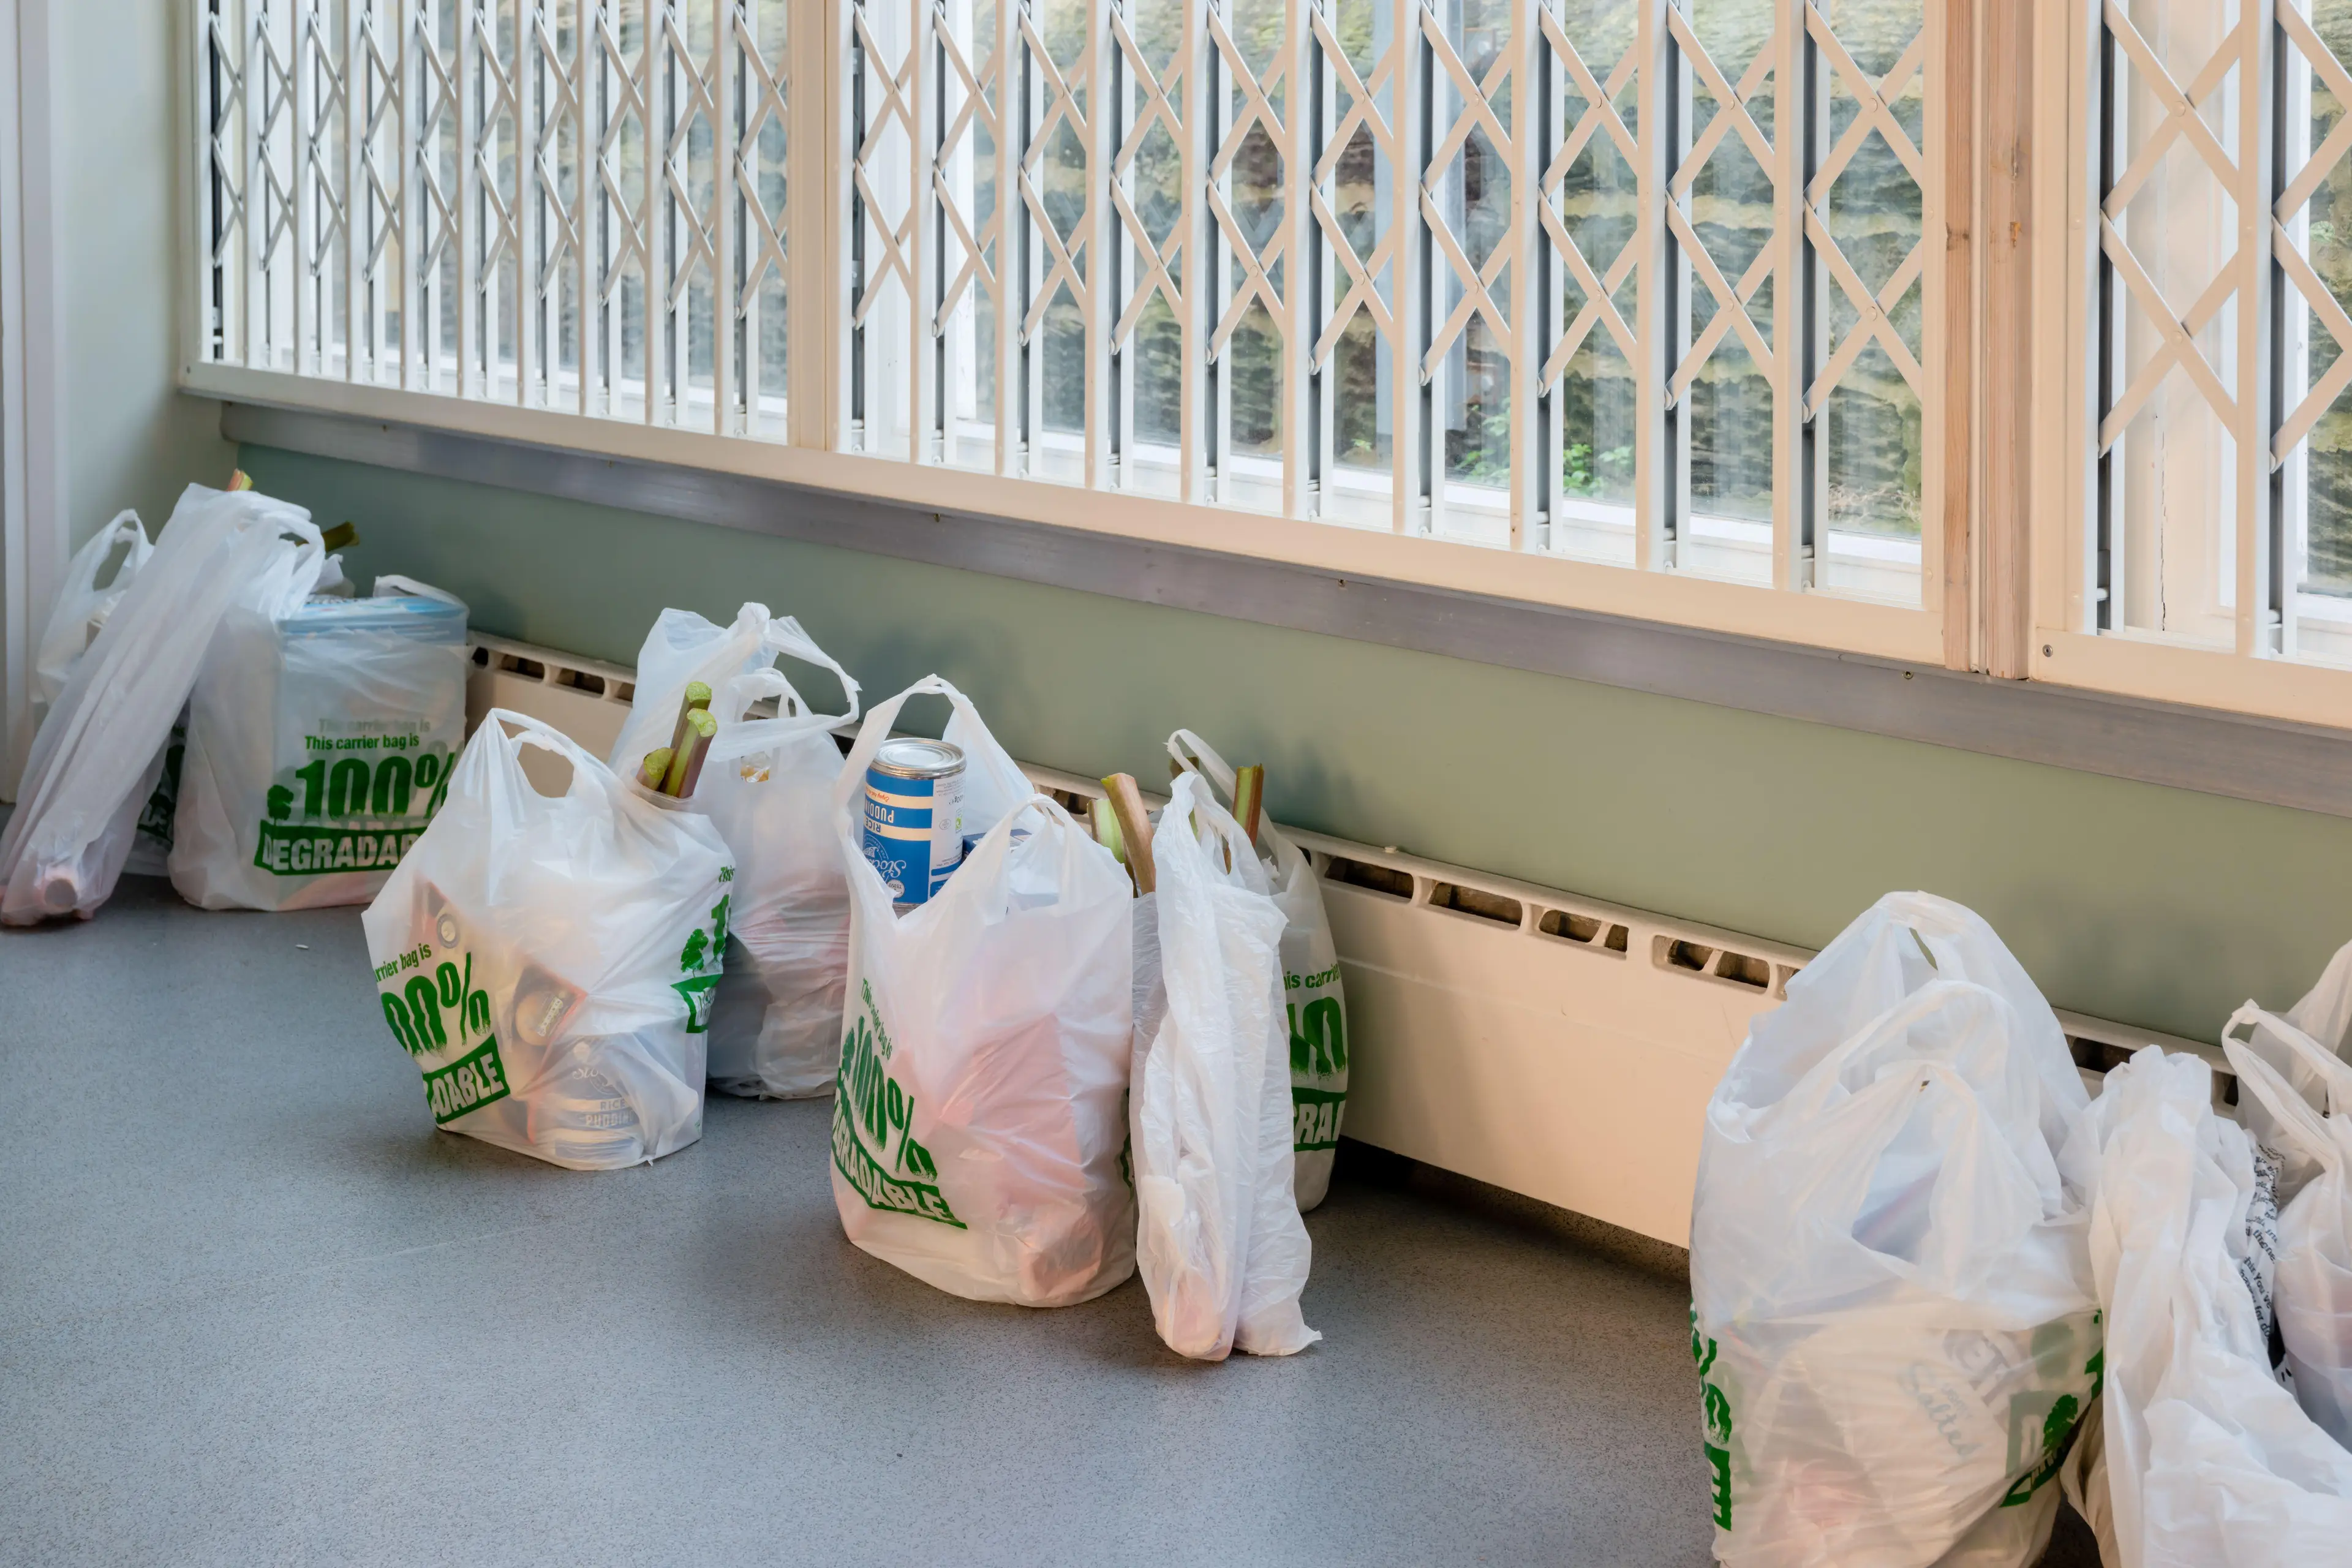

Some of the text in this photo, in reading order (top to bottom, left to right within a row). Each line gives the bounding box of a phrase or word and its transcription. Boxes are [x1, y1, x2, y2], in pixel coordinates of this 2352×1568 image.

[305, 733, 420, 750] This carrier bag is
[295, 752, 456, 821] 100%
[865, 817, 881, 833] RICE
[375, 942, 432, 982] rrier bag is
[380, 951, 491, 1057] 00%
[885, 1037, 892, 1060] is
[429, 1052, 505, 1118] DABLE
[600, 1099, 625, 1111] RICE
